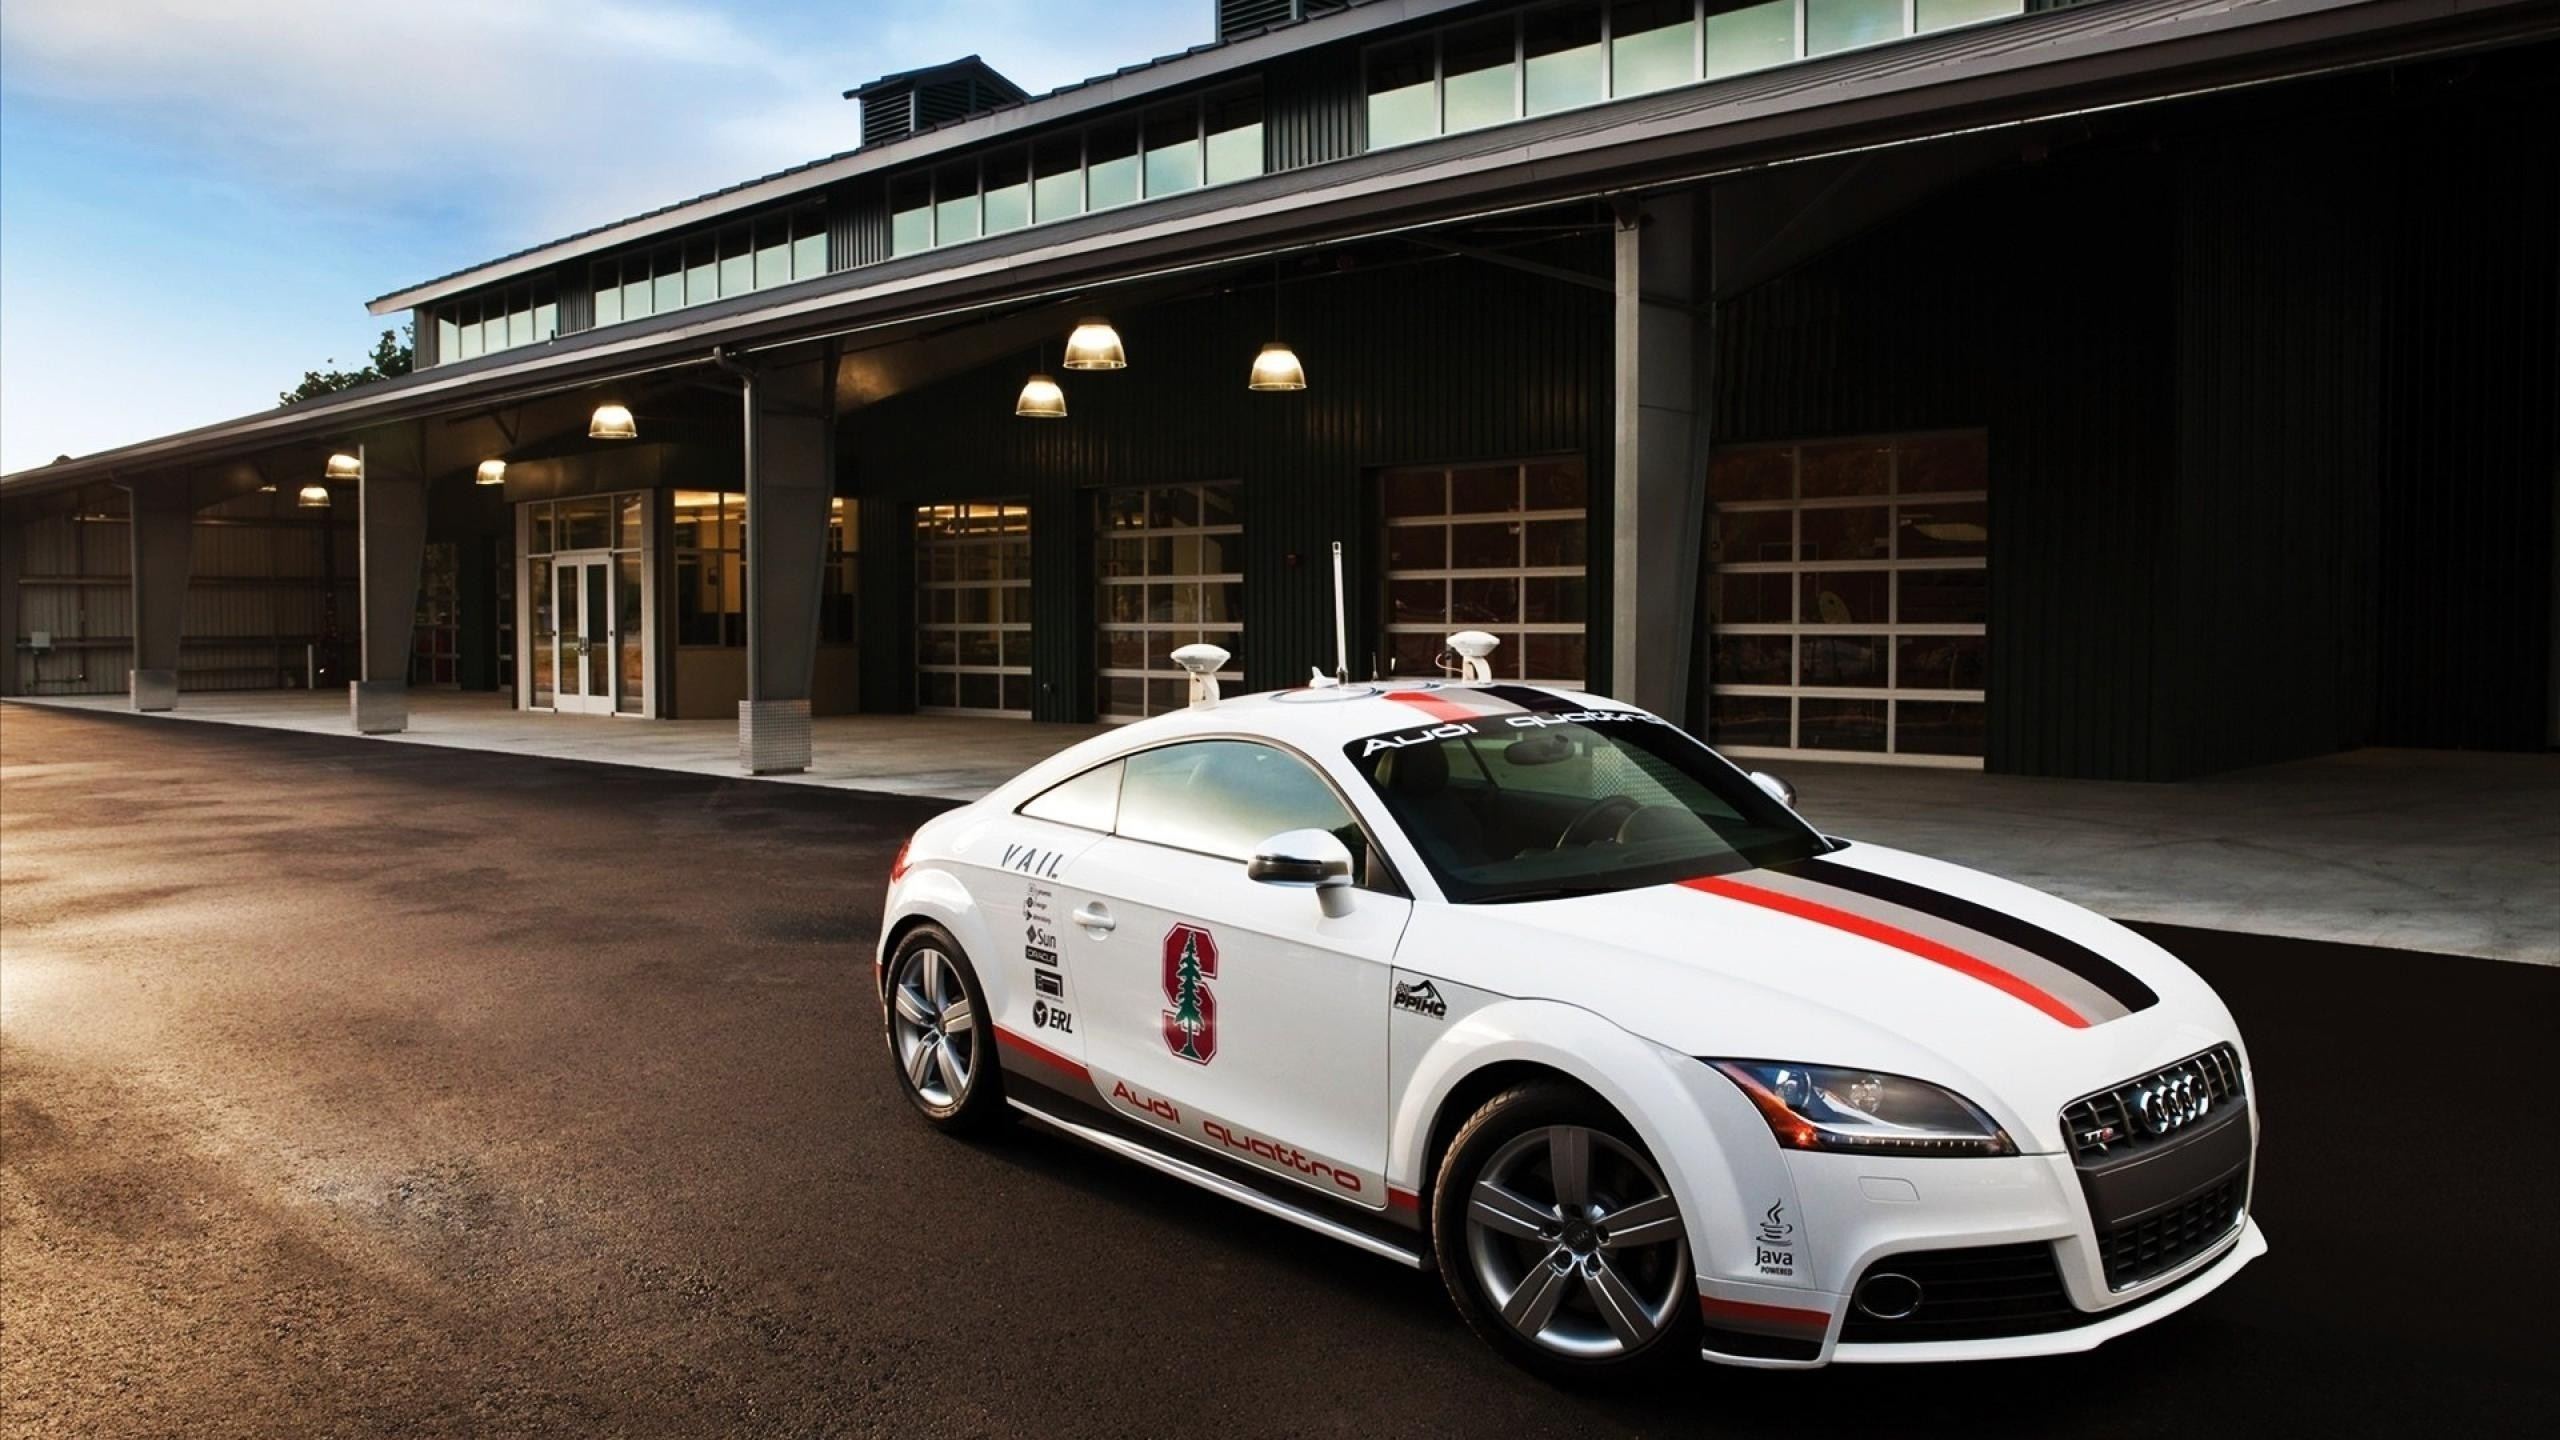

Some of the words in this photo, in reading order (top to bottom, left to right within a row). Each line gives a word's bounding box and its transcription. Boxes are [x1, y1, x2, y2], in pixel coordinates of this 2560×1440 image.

[1363, 724, 1480, 757] Audi
[1037, 928, 1056, 948] Sun
[1049, 1008, 1073, 1034] ERL
[1113, 1081, 1181, 1124] Audi
[1204, 1119, 1361, 1193] quattro
[1755, 1246, 1792, 1266] Java
[1761, 1266, 1792, 1276] POWERED
